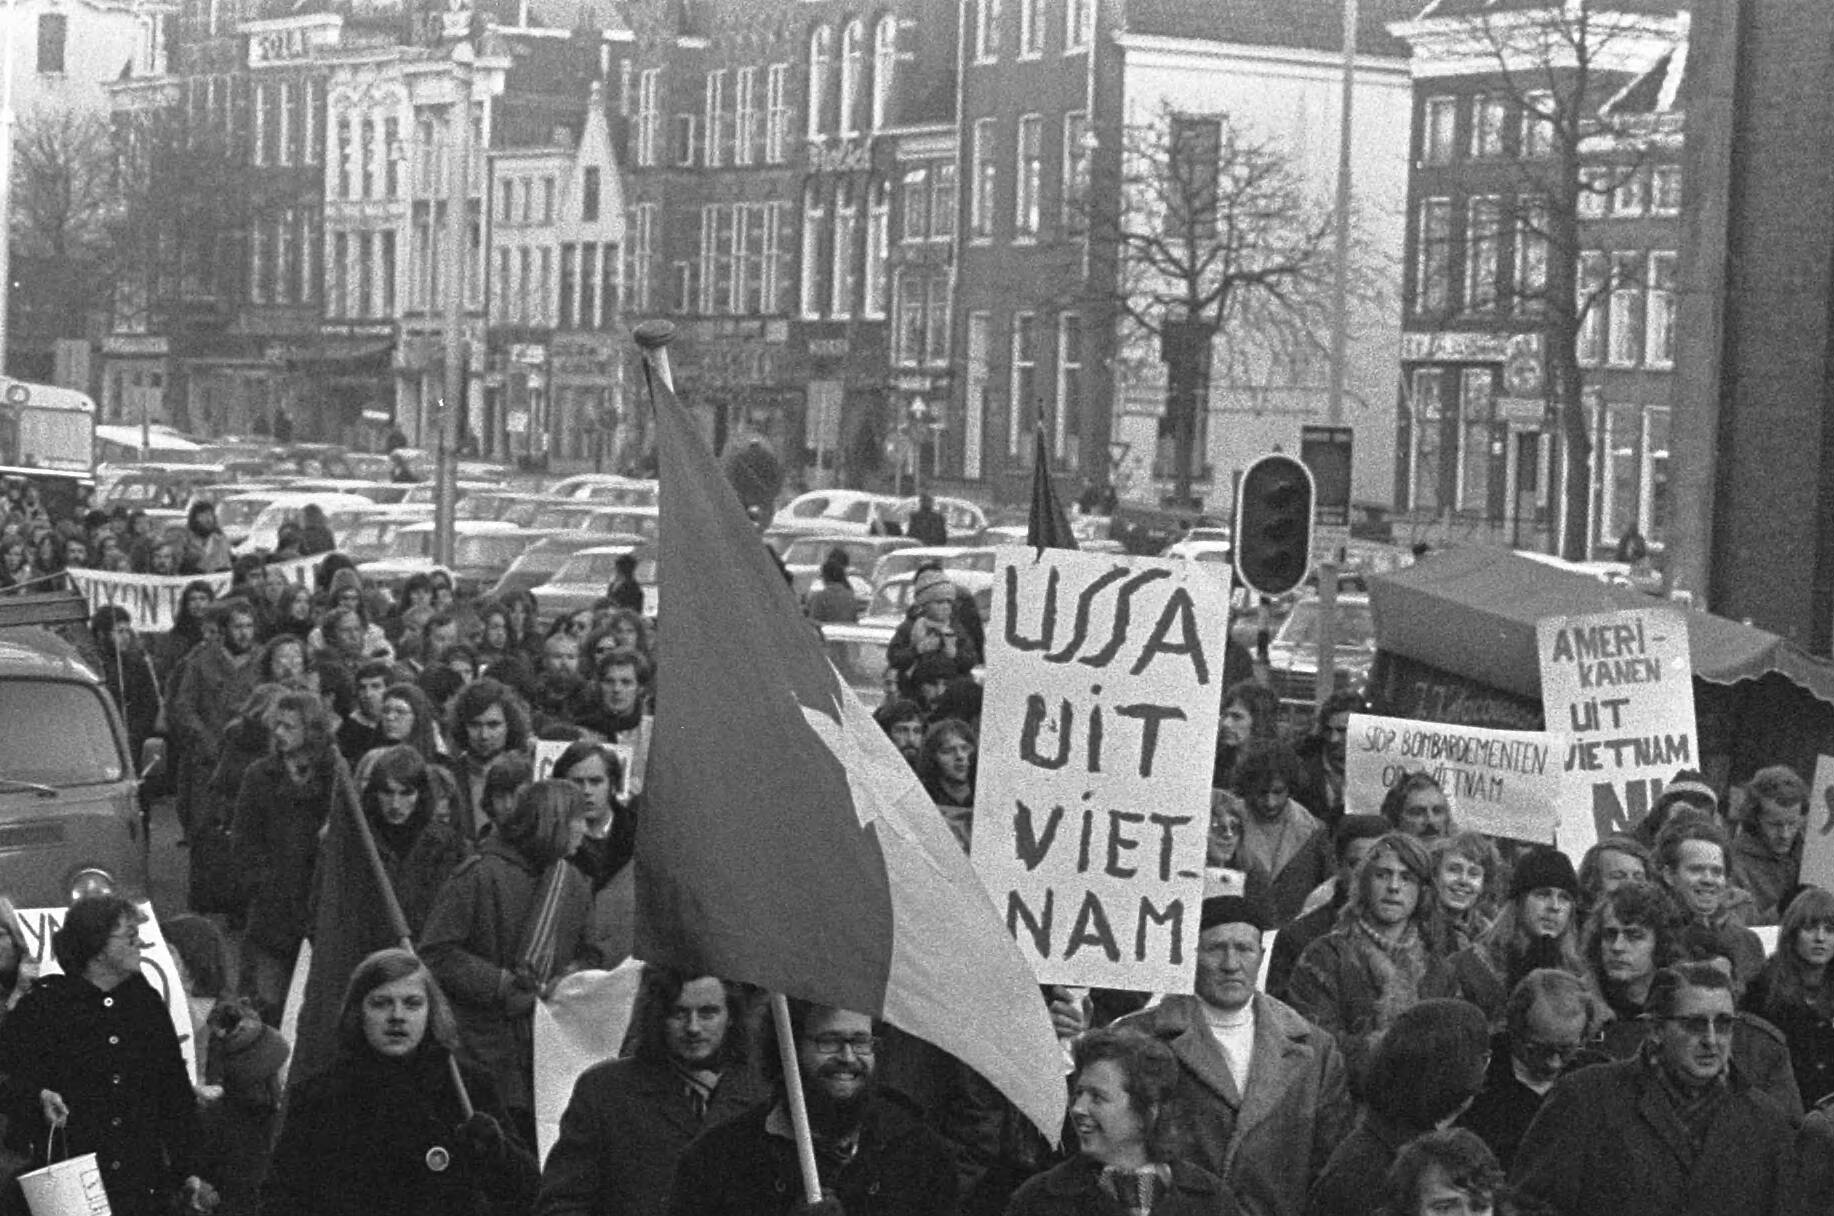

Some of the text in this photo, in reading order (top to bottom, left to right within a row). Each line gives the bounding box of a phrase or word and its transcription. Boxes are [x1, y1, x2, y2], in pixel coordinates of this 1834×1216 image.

[1004, 563, 1210, 685] USSA
[1578, 656, 1662, 688] KANEN
[1400, 730, 1549, 776] BOMBARDEMENTEN
[1592, 777, 1664, 838] N
[1006, 888, 1184, 964] NAM
